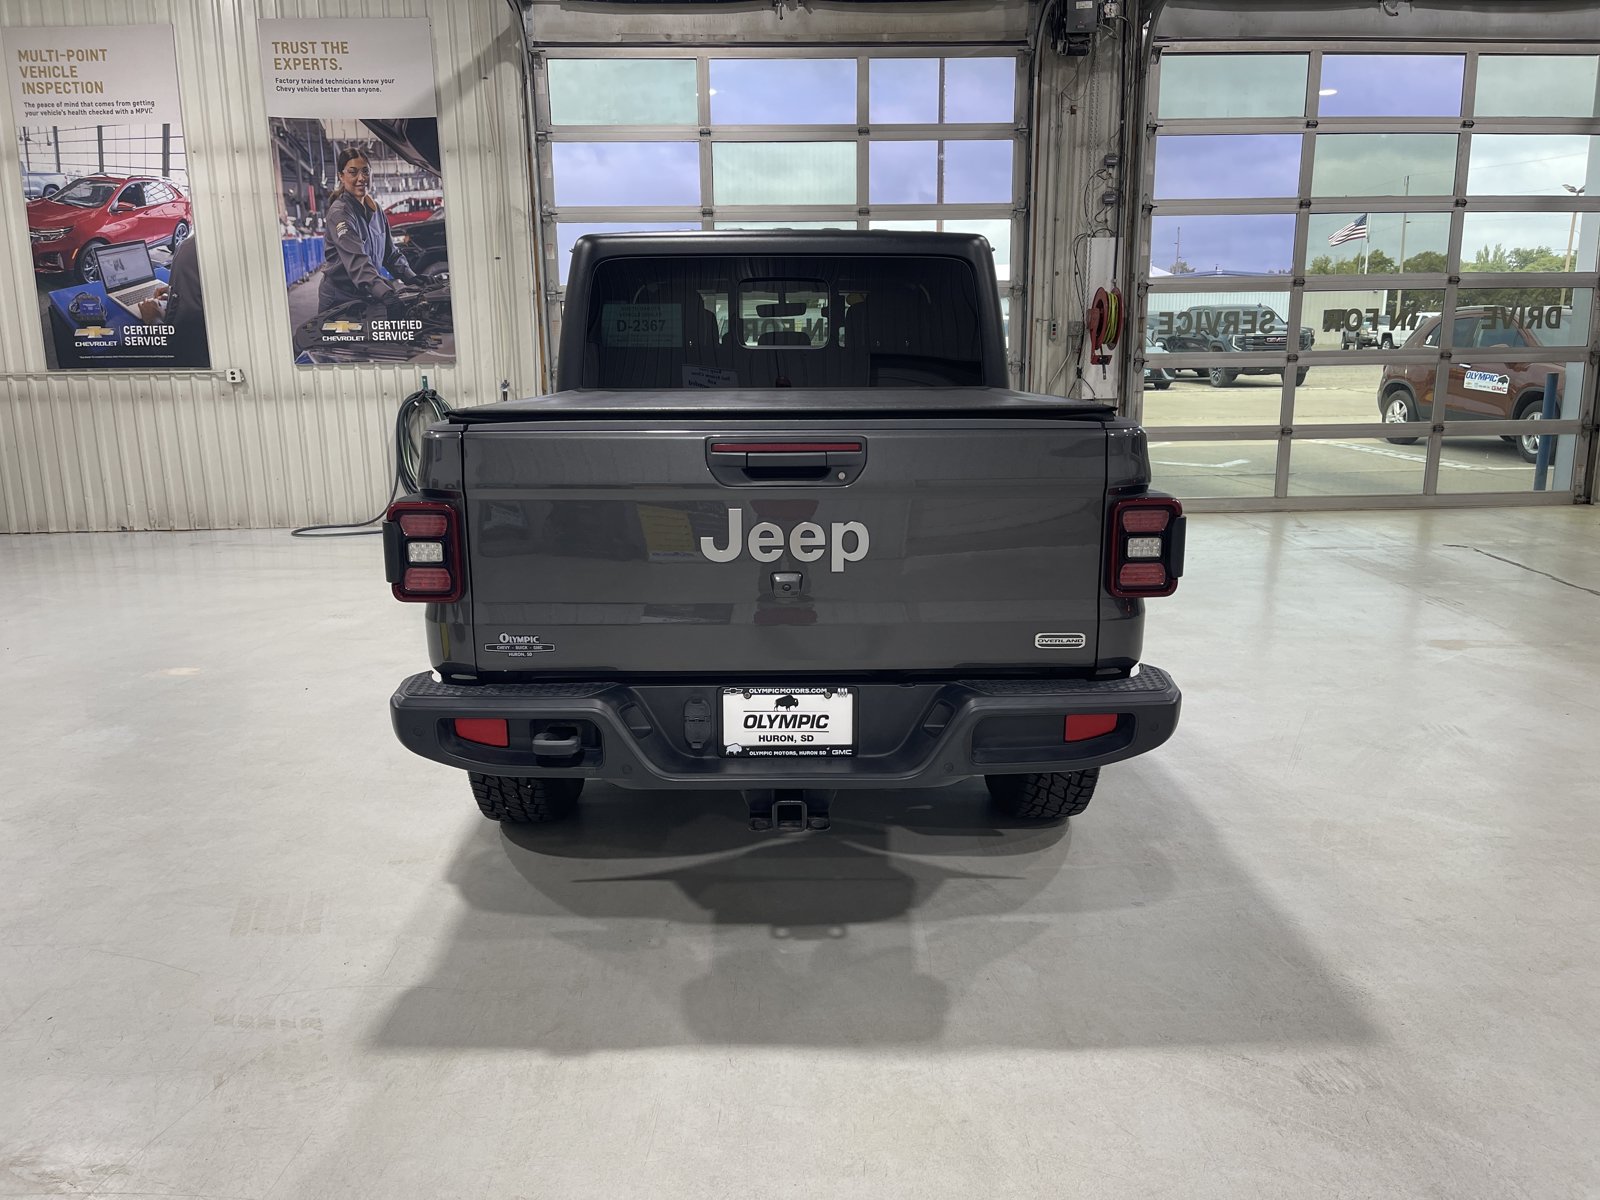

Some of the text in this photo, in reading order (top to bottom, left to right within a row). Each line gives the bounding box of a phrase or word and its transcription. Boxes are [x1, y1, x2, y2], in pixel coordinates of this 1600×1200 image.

[272, 41, 349, 54] TRUST THE
[18, 48, 108, 62] MULTI-POINT
[273, 58, 342, 70] EXPERTS.
[19, 65, 78, 78] VEHICLE
[275, 77, 300, 85] Factory
[21, 81, 104, 94] INSPECTION
[123, 325, 174, 335] CERTIFIED
[371, 320, 422, 330] CERTIFIED
[616, 320, 666, 332] D-2367
[124, 336, 167, 346] SERVICE
[372, 331, 414, 341] SERVICE
[1466, 372, 1498, 382] OLYMPIC
[700, 508, 870, 572] Jeep
[743, 714, 829, 729] OLYMPIC
